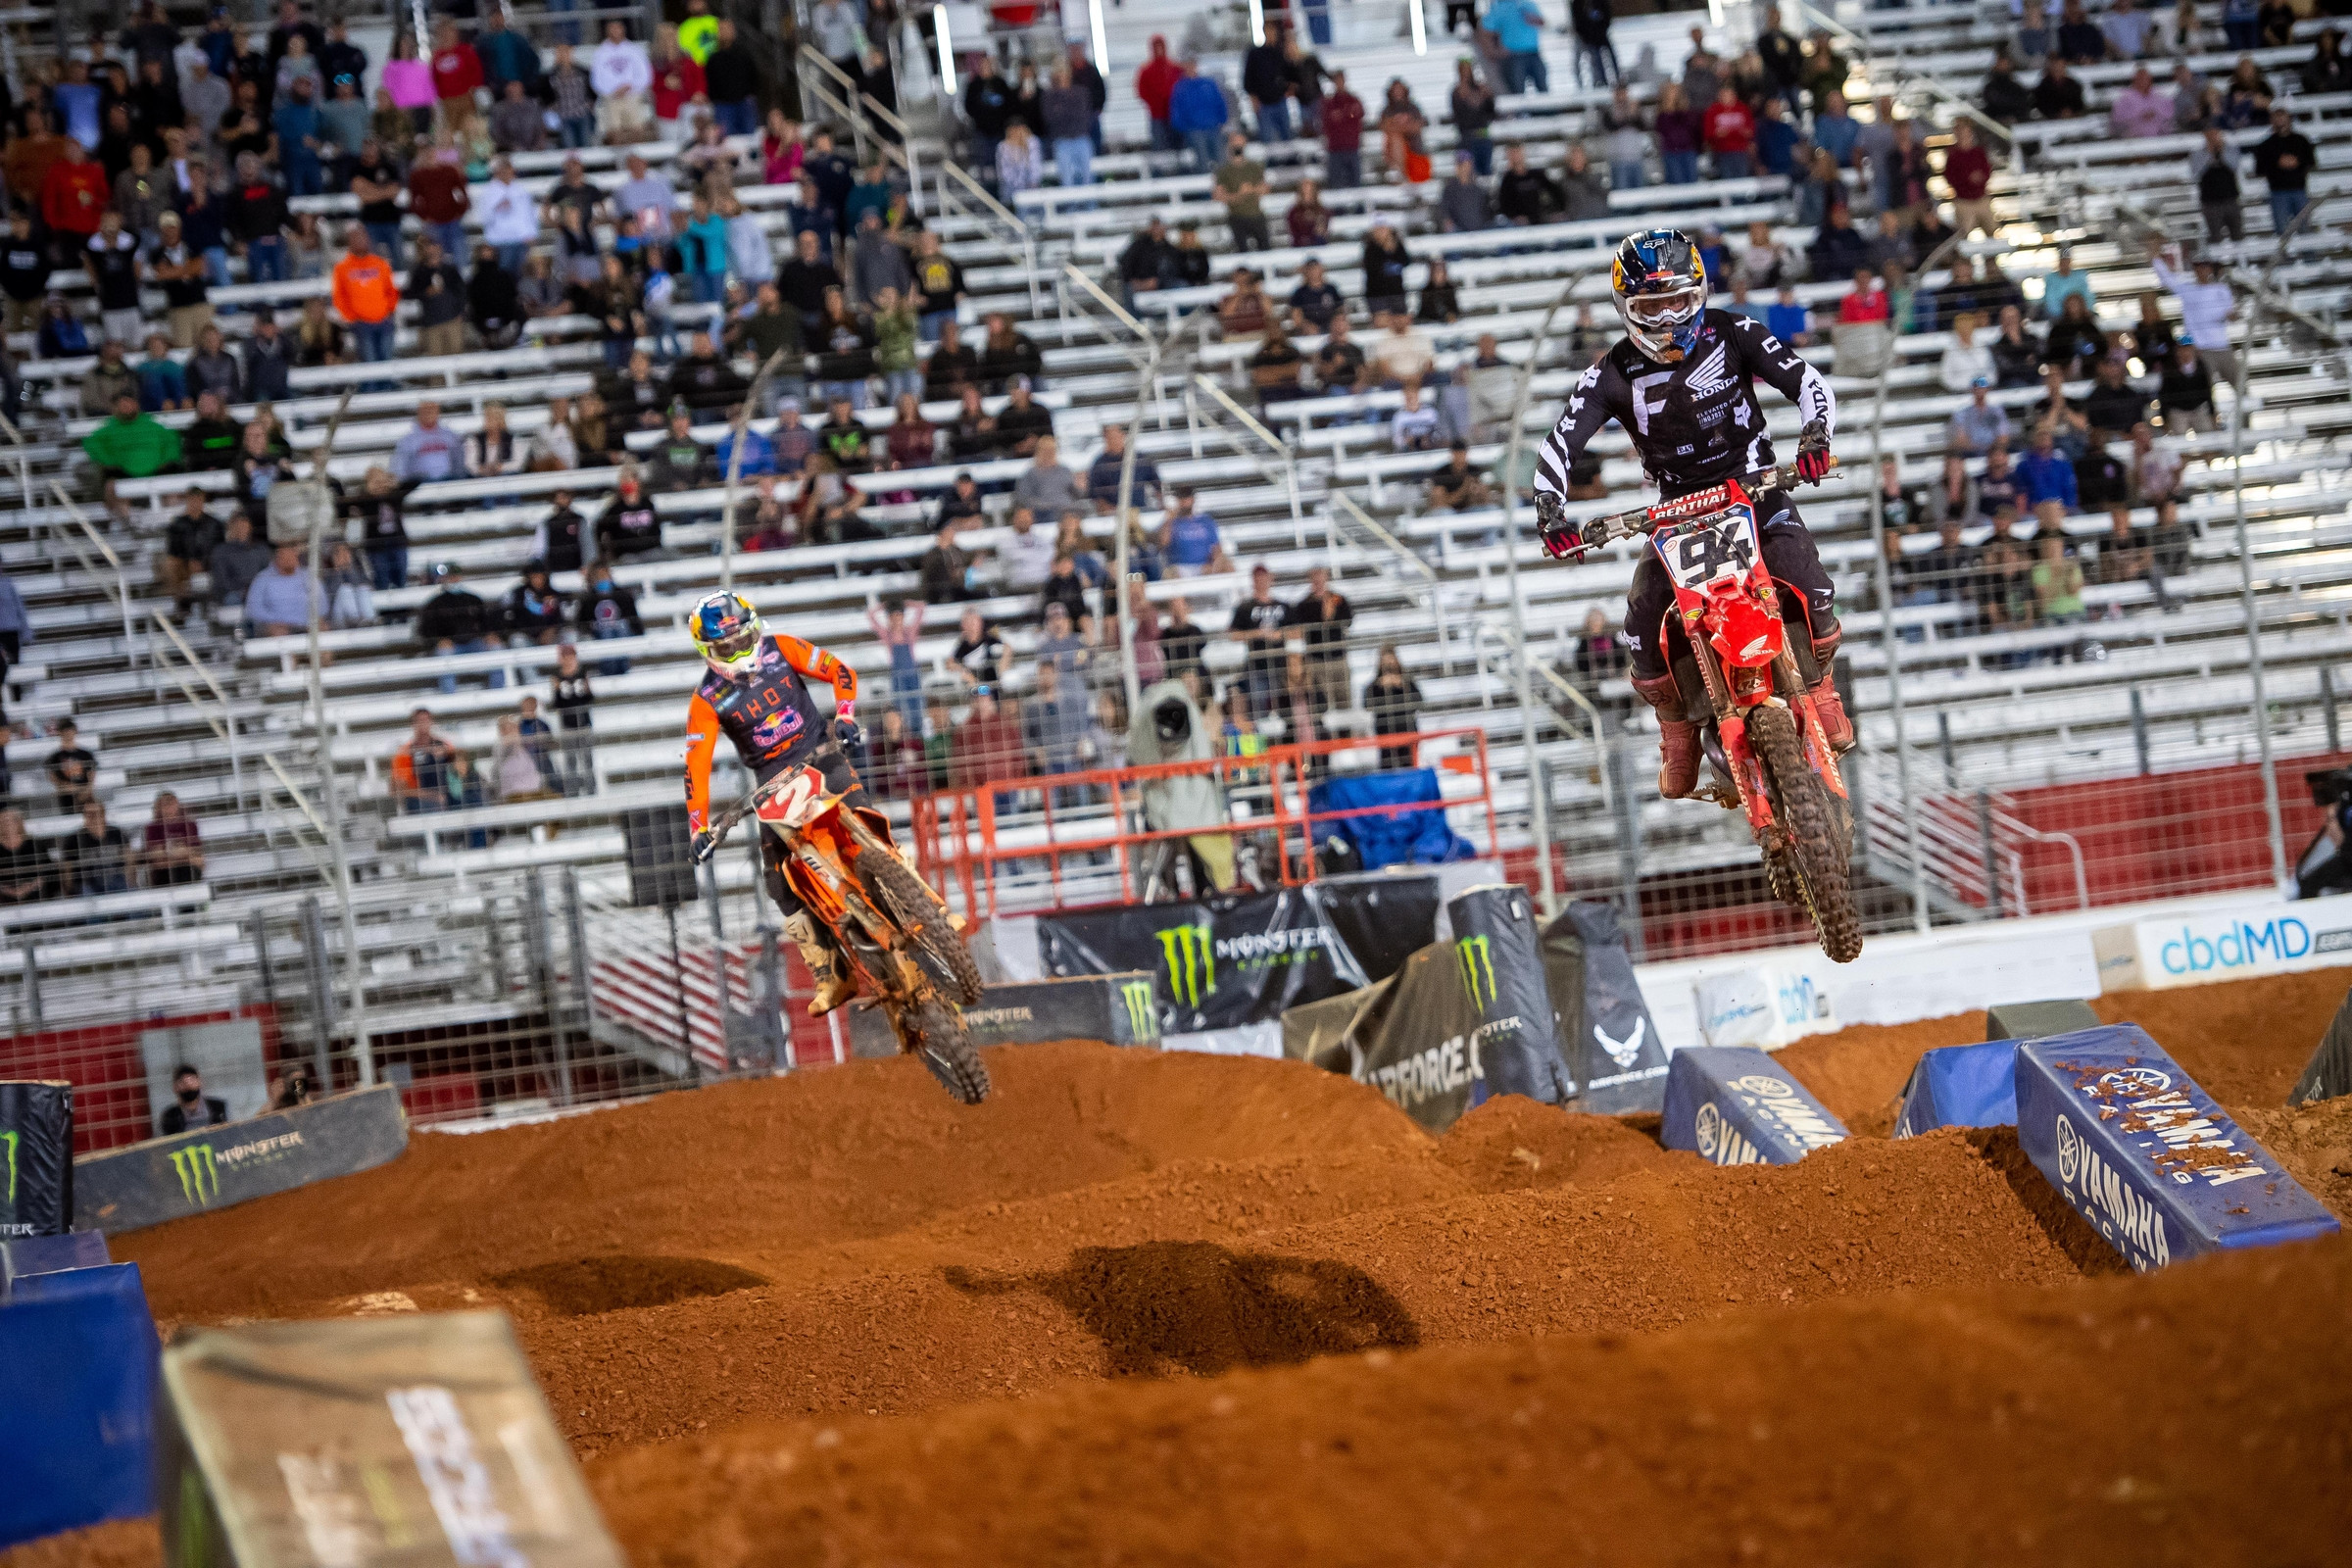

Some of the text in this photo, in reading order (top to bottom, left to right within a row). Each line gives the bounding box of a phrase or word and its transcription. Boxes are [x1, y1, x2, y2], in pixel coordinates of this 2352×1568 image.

[1808, 379, 1830, 424] ONDA
[1655, 492, 1731, 519] RENTHAL
[1680, 521, 1753, 588] 94
[1741, 648, 1776, 662] HONDA
[1813, 719, 1845, 790] DUNLOP
[1725, 750, 1753, 818] DUNLOP
[1215, 926, 1328, 960] MONSTER
[2161, 917, 2311, 974] cbdMD
[961, 1005, 1033, 1026] ONSTER
[215, 1131, 304, 1165] MONSTER
[2079, 1135, 2170, 1268] YAMAHA
